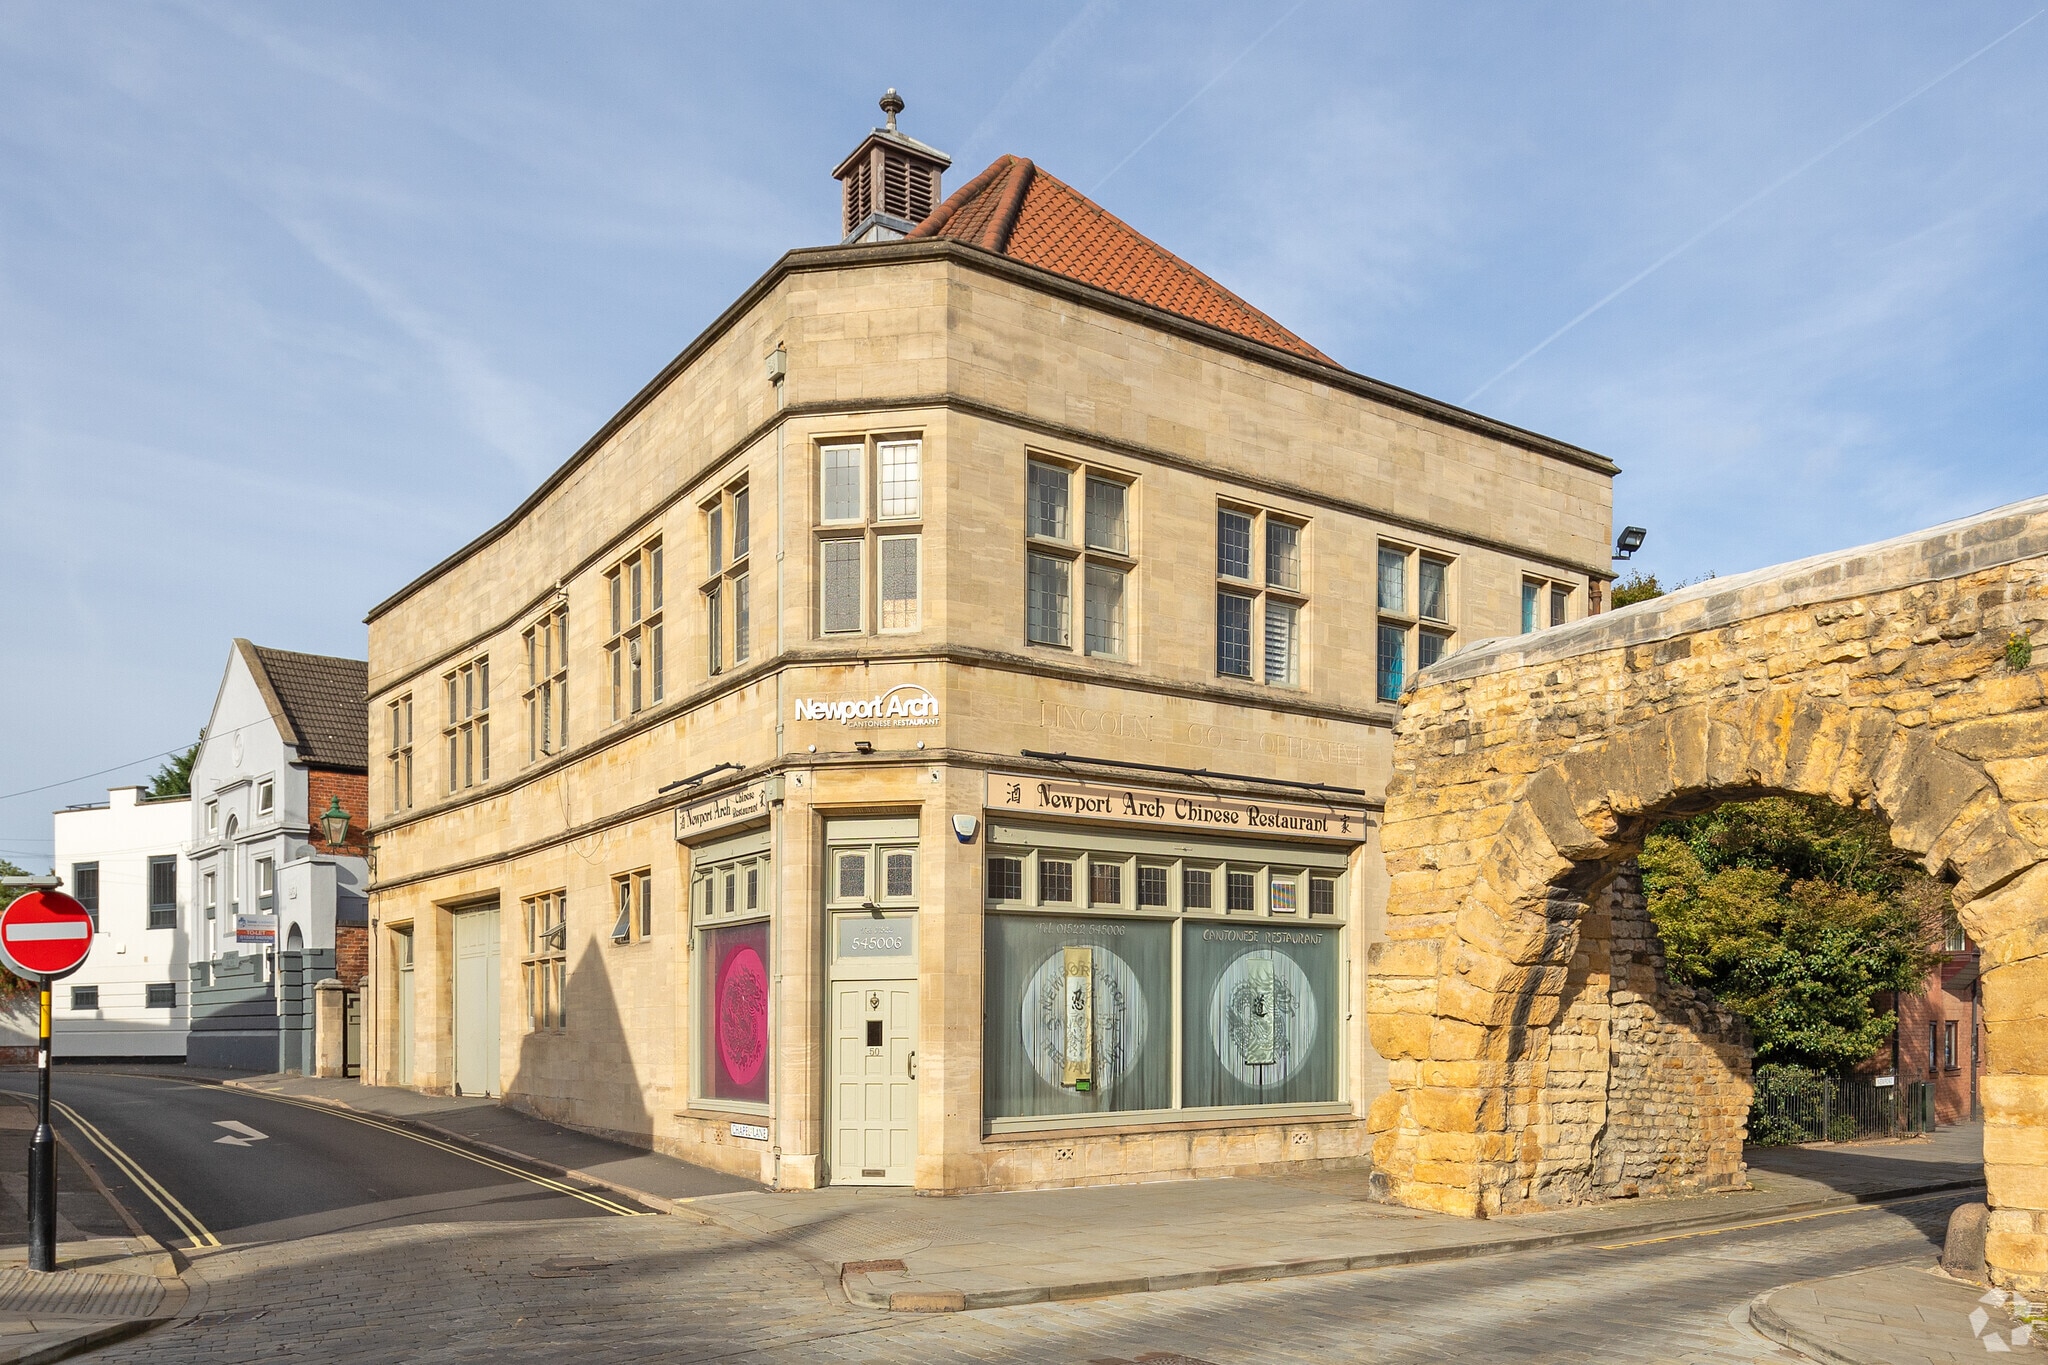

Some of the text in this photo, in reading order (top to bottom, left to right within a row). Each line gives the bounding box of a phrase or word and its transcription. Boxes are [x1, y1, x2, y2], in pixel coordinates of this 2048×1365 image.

[795, 693, 939, 724] Newport Arch
[848, 718, 939, 728] CANTONESE RESTAURANT
[1040, 703, 1149, 739] LINCOLN
[734, 791, 755, 804] Chinese
[1006, 782, 1021, 804] 酒
[686, 799, 731, 828] Newport Arch
[732, 803, 758, 818] Restaurant
[1037, 783, 1328, 832] Newport Arch Chinese Restaurant
[1339, 814, 1352, 834] 家
[1056, 923, 1086, 935] 01522
[1089, 924, 1126, 936] 545006
[1203, 928, 1323, 944] CANTONESE RESTAURANT
[852, 936, 902, 950] 545006
[869, 1047, 880, 1056] 50
[732, 1124, 766, 1139] CHAPEL LANE
